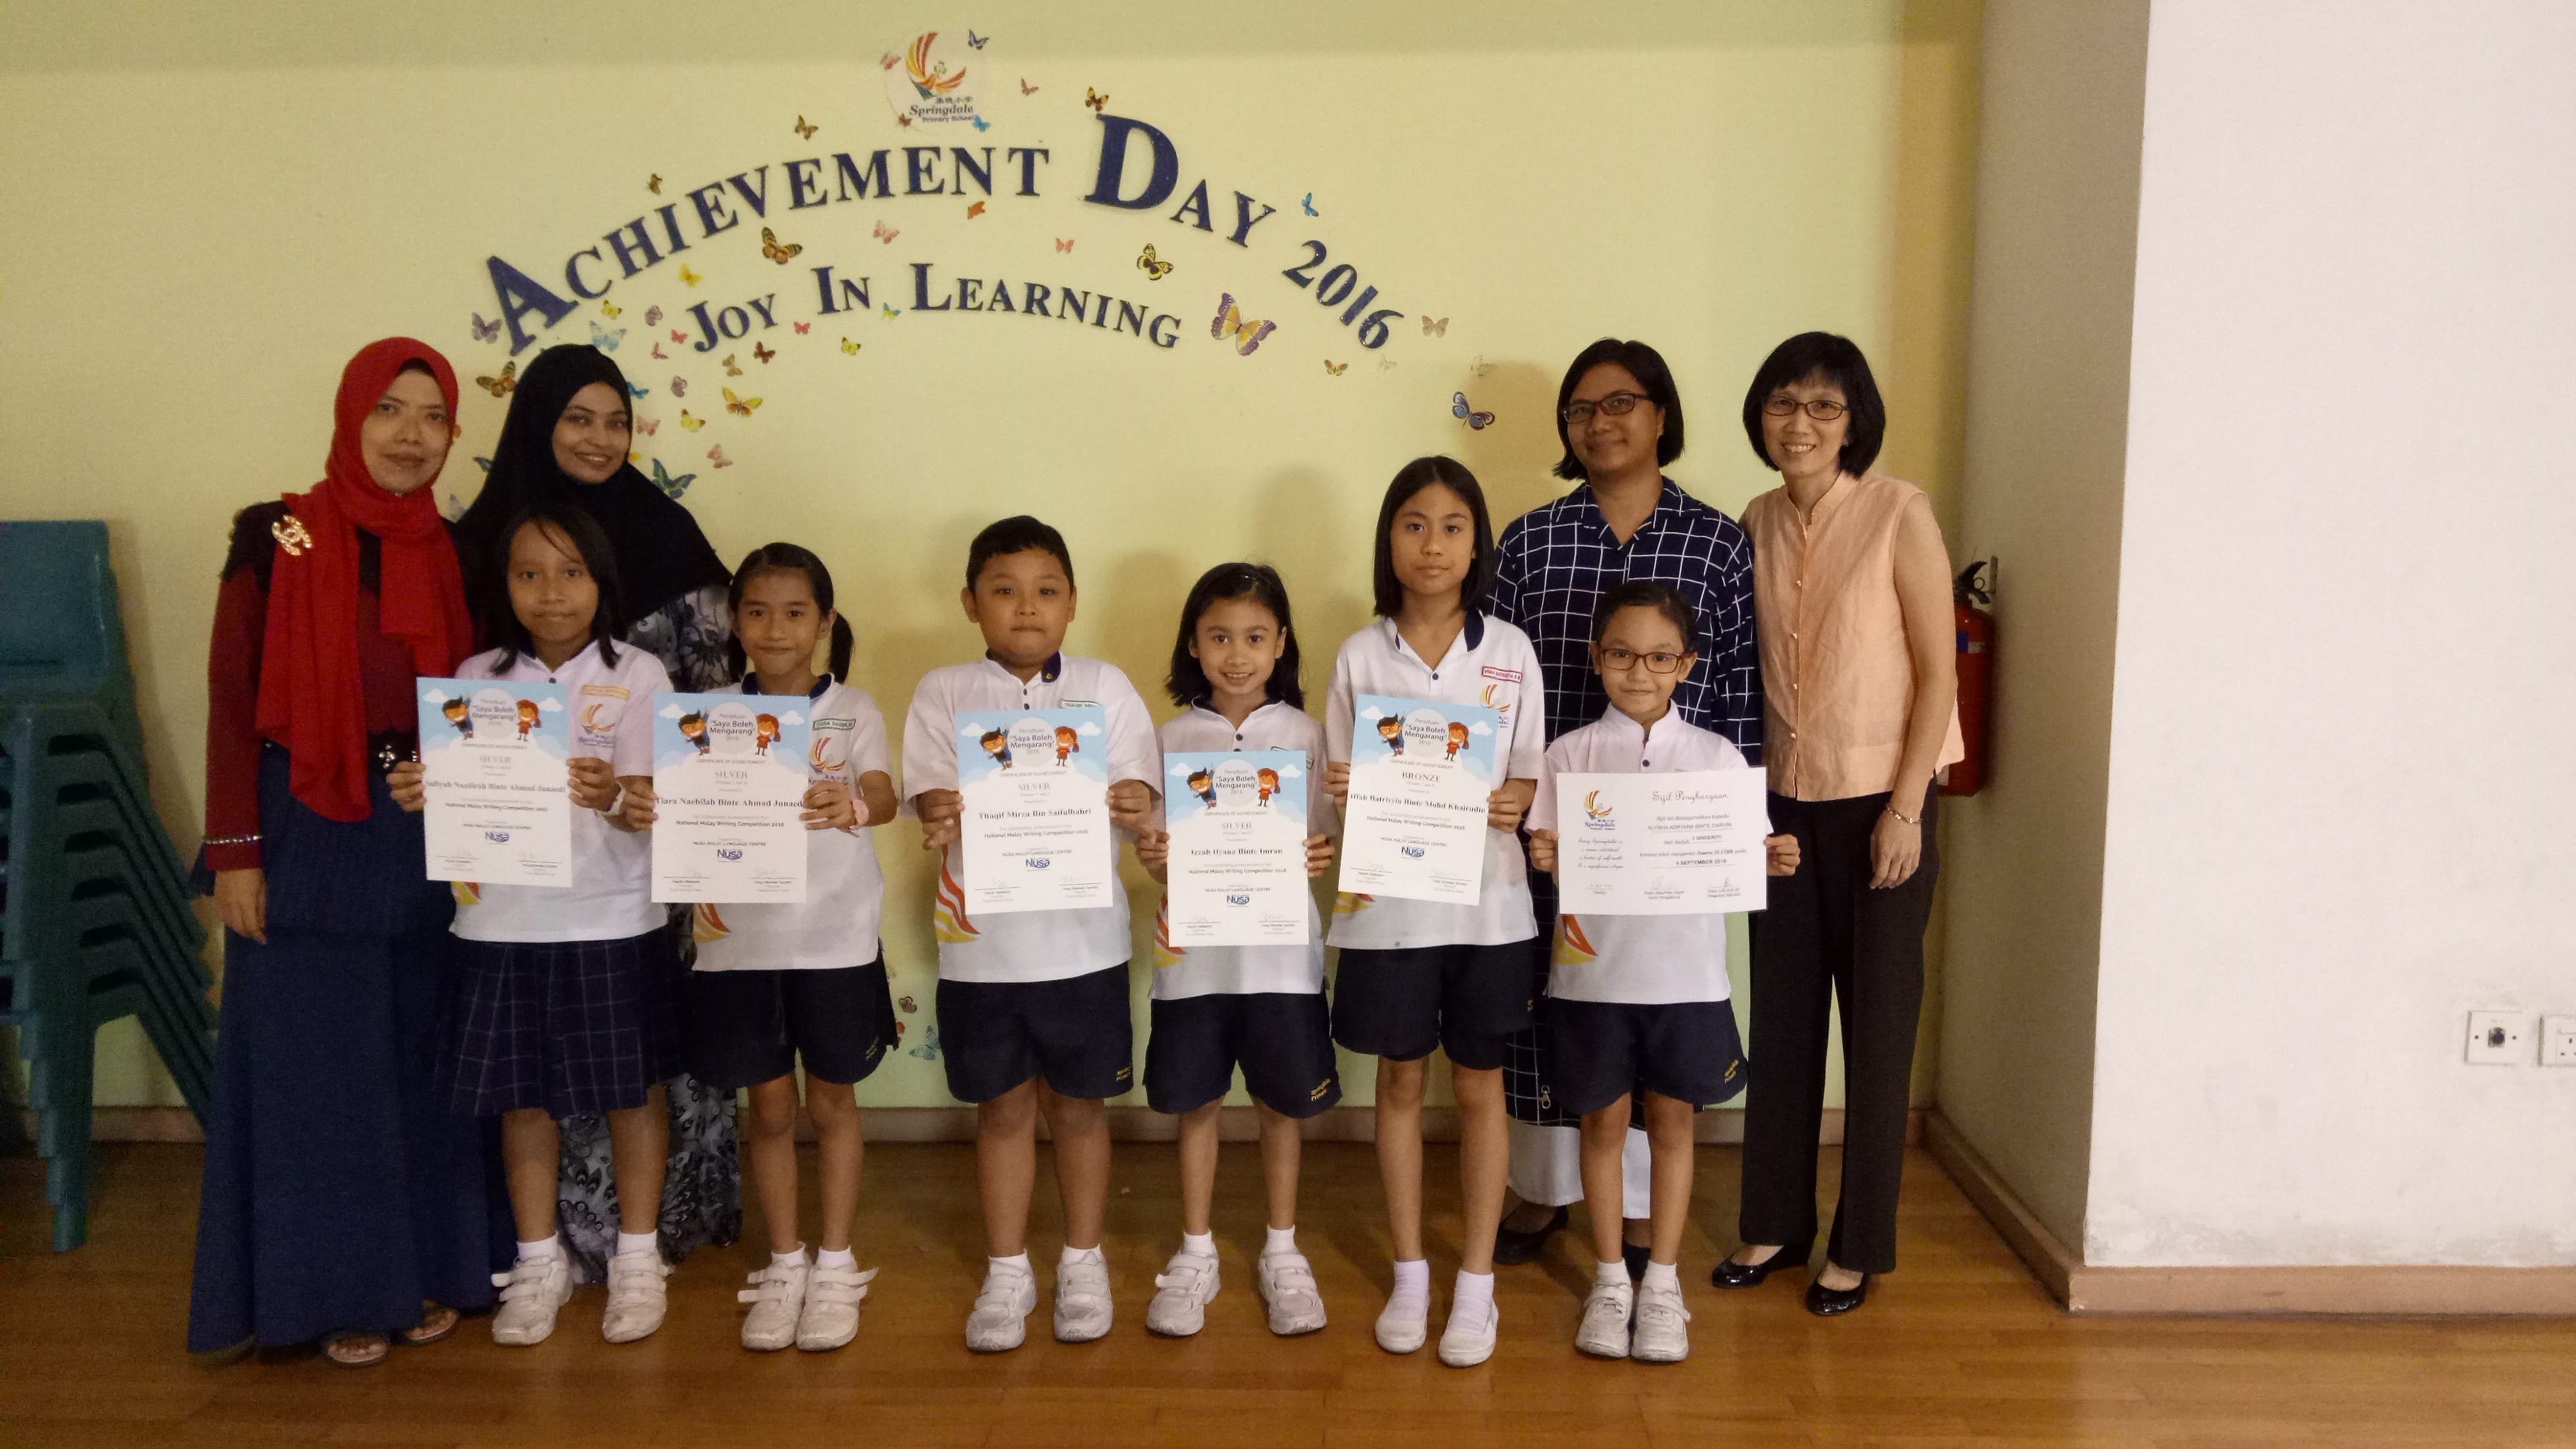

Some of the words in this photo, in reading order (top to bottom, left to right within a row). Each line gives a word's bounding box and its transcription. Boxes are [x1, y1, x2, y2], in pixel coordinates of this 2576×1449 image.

[909, 104, 973, 118] Springdale
[486, 145, 1050, 356] ACHIEVEMENT
[1084, 114, 1276, 247] DAY
[1282, 240, 1404, 350] 2016
[686, 292, 777, 353] JOY
[811, 265, 870, 316] IN
[909, 262, 1182, 349] LEARNING
[1426, 726, 1445, 734] Boleh
[714, 770, 748, 779] SILVER
[1402, 771, 1441, 783] BRONZE
[1018, 782, 1051, 791] SILVER
[1675, 790, 1728, 805] Penghargaan
[1404, 798, 1423, 806] Binte
[1424, 800, 1446, 809] Mohd
[978, 811, 1005, 820] Thaqif
[1048, 807, 1092, 816] Saifulbahri
[1222, 822, 1253, 830] SILVER
[1422, 821, 1452, 830] Competition
[718, 849, 743, 860] Nusa
[1401, 845, 1424, 857] Nusa
[1025, 857, 1050, 869] Nusa
[1226, 895, 1250, 905] Nusa
